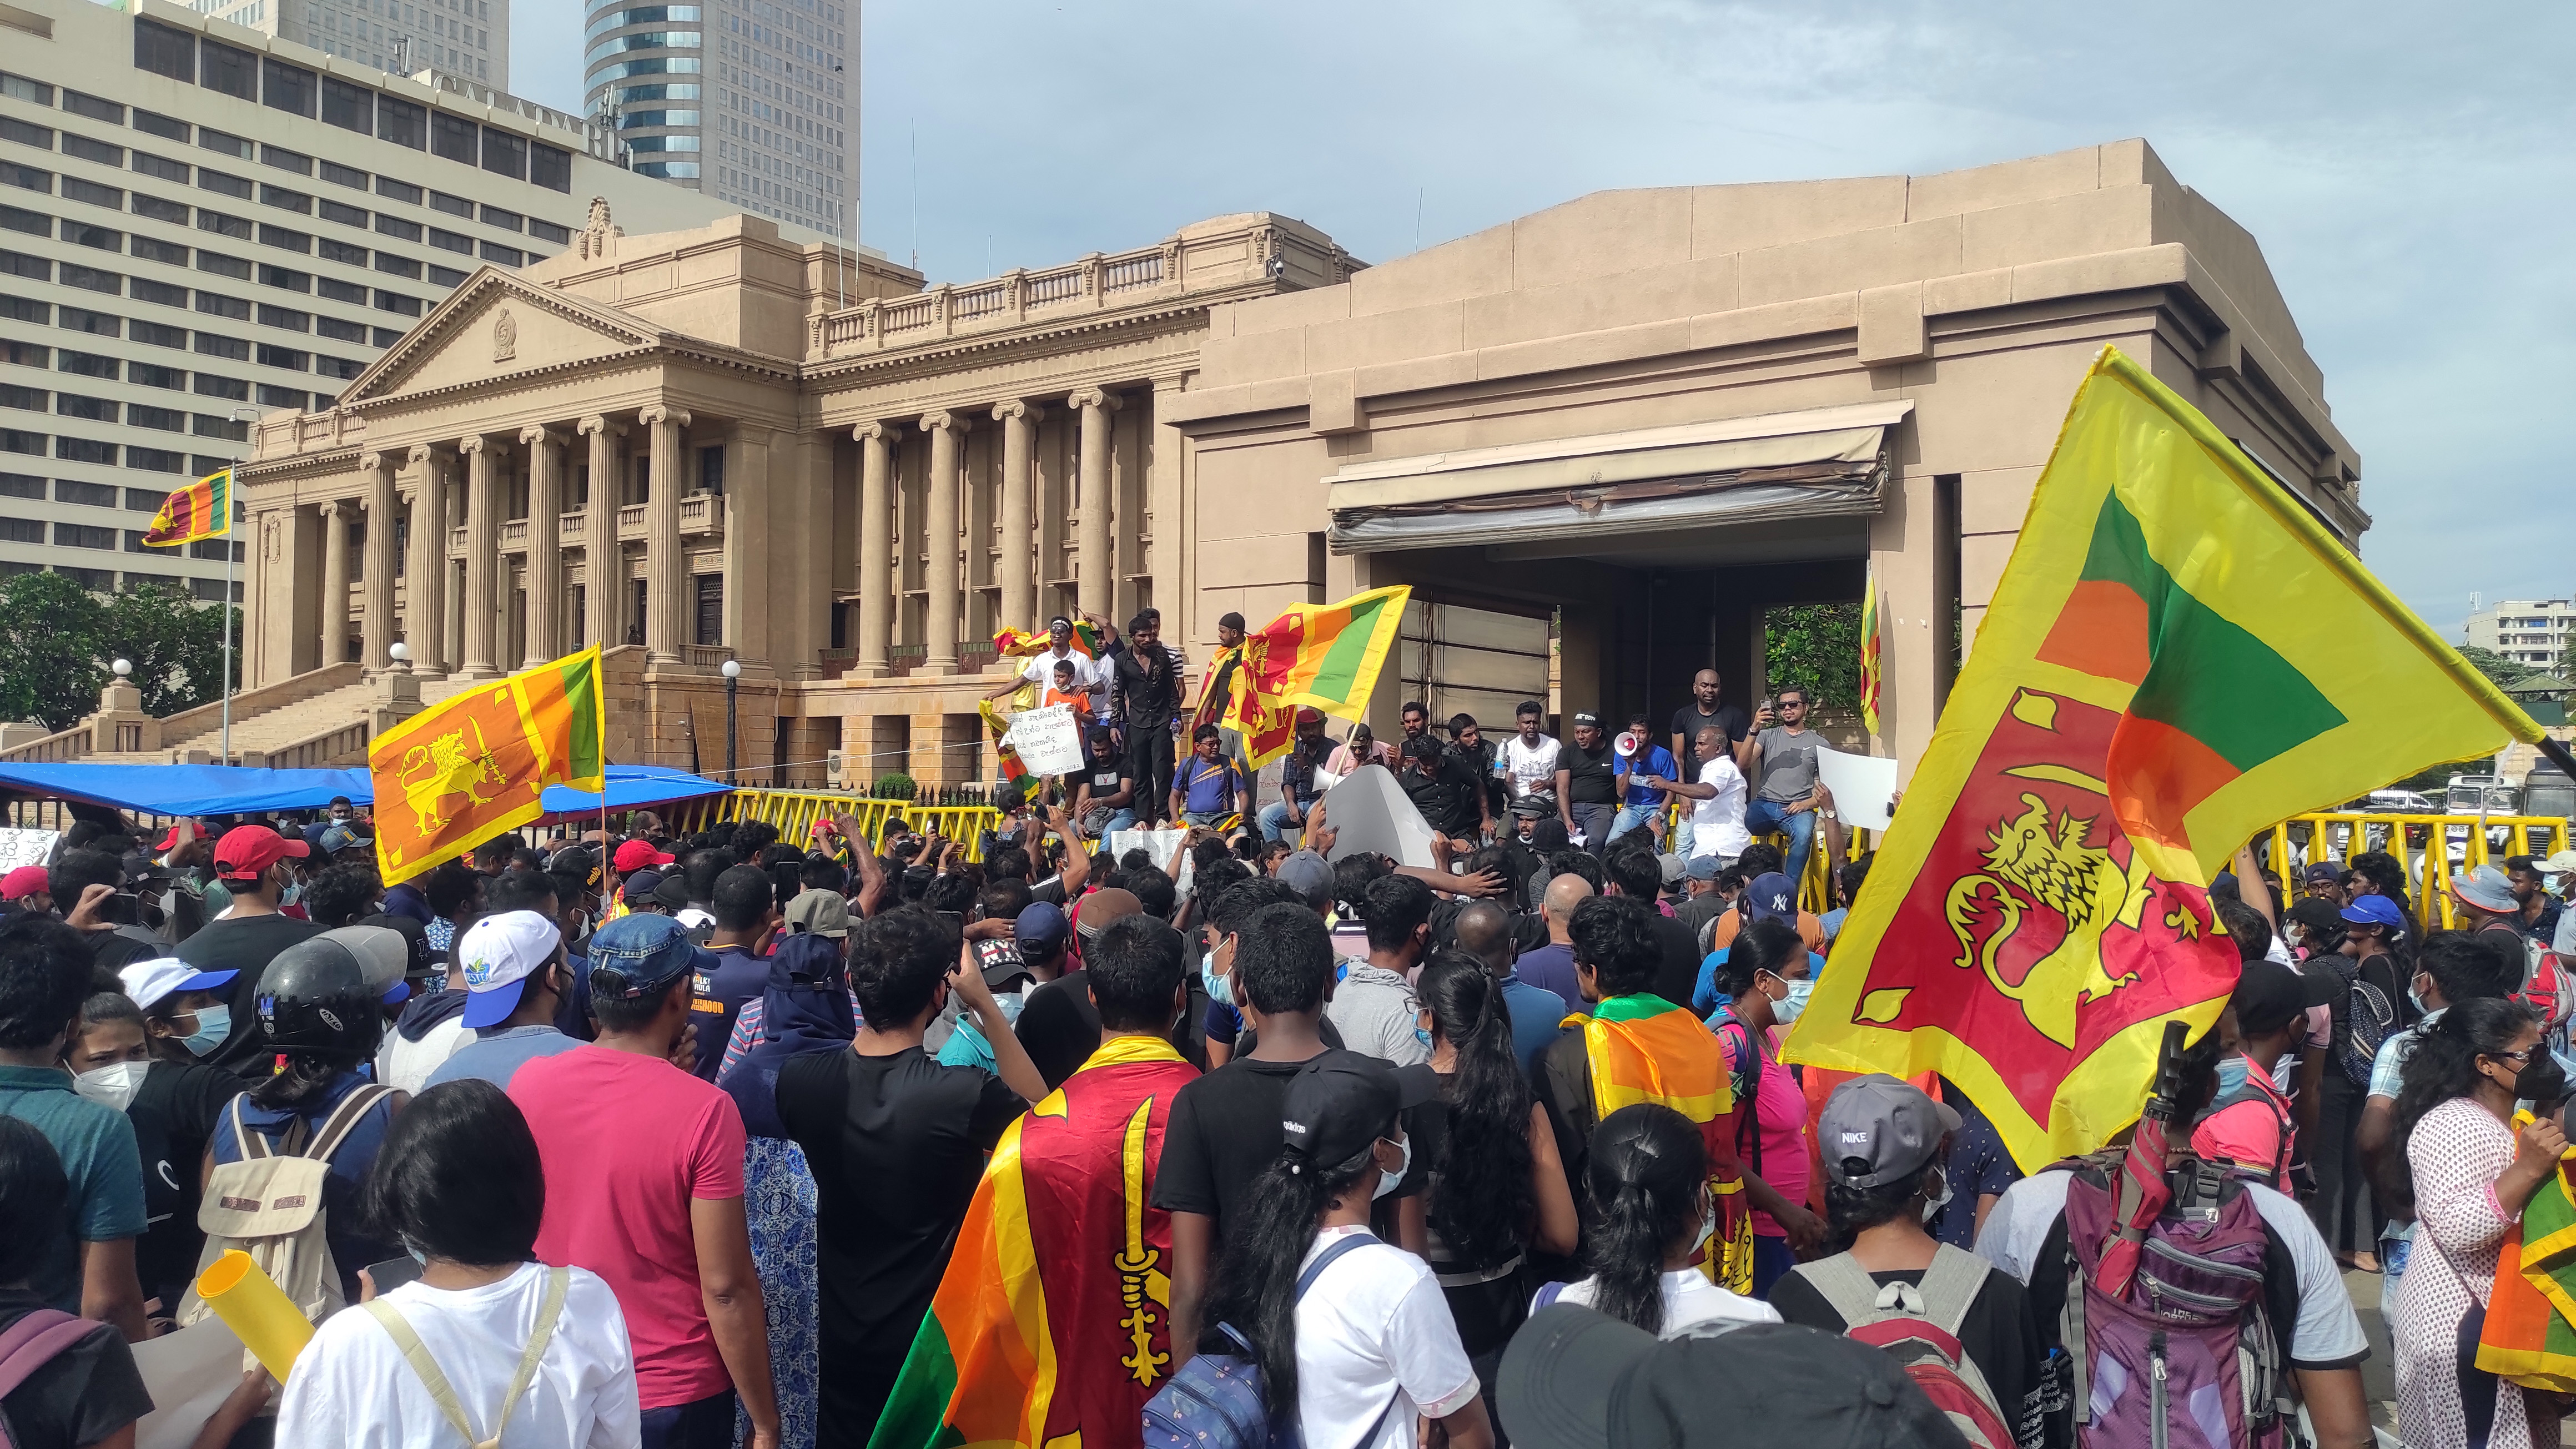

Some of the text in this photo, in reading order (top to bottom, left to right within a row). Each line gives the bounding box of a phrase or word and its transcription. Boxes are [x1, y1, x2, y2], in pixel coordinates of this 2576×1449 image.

[1772, 893, 1788, 912] NY
[702, 999, 724, 1014] HOOD
[1283, 1120, 1306, 1134] adidas
[1842, 1132, 1867, 1144] NIKE
